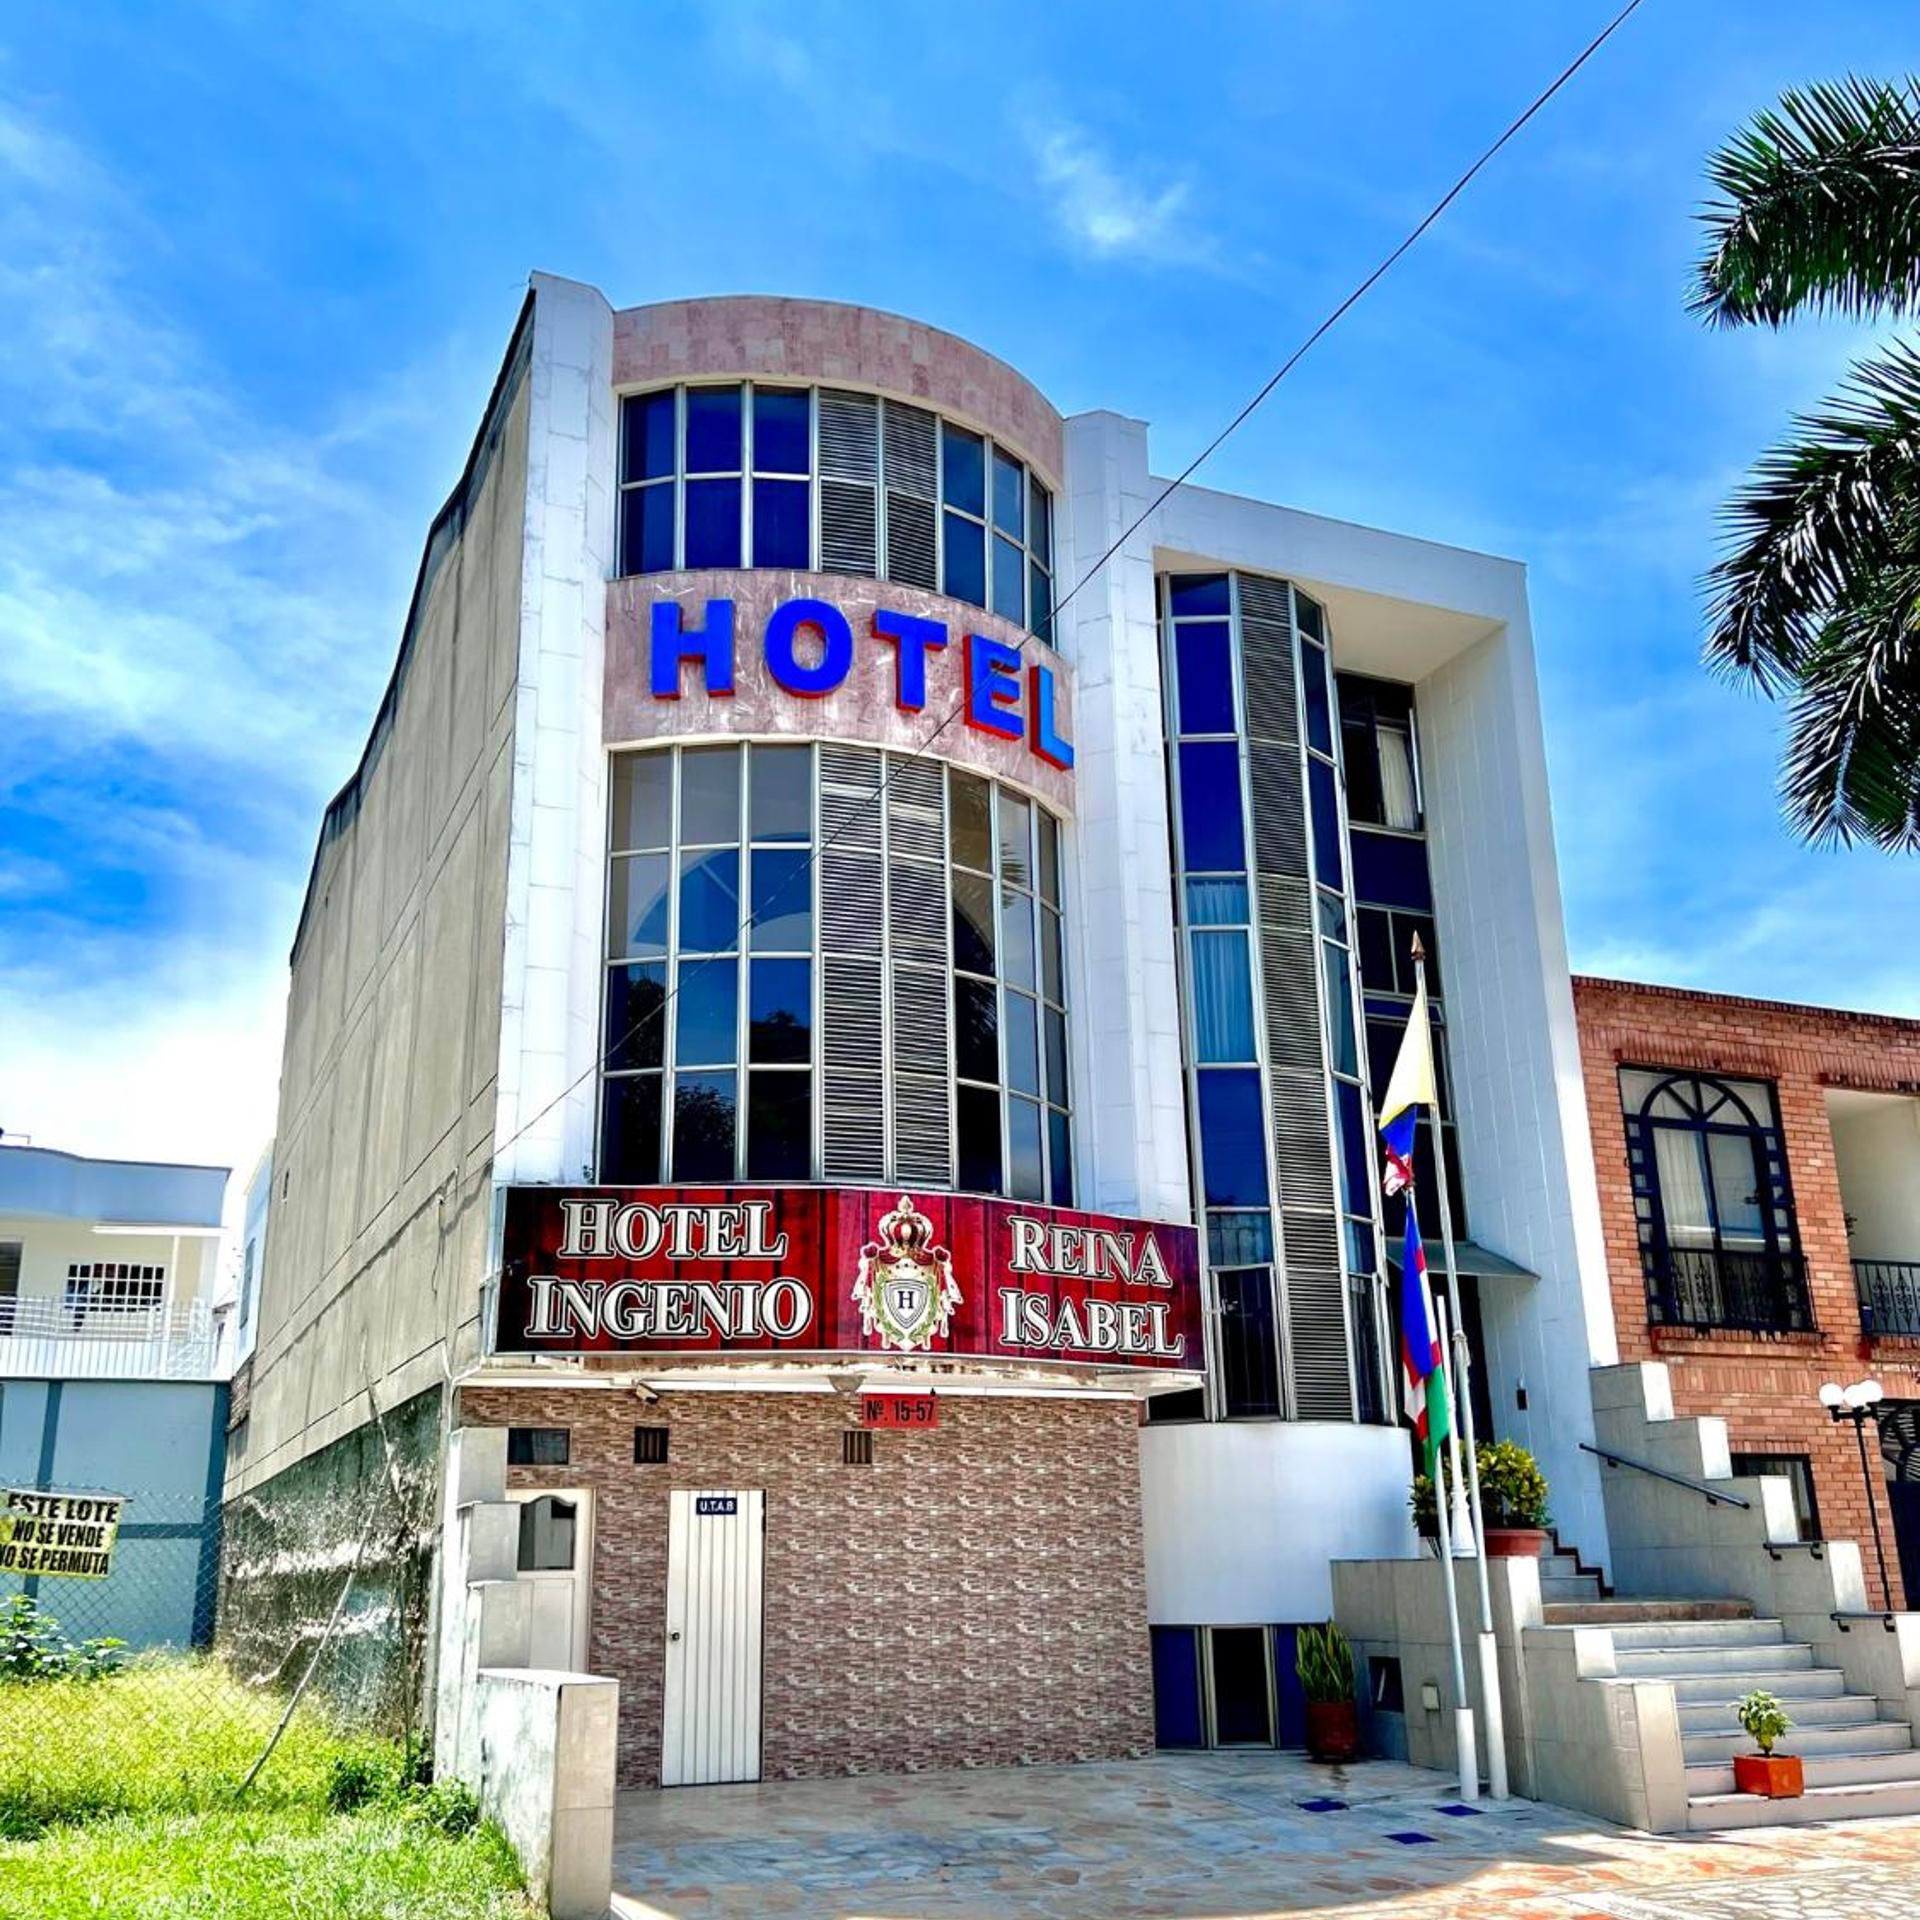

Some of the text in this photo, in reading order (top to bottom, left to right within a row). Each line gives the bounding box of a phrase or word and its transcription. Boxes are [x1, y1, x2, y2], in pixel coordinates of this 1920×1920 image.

[650, 598, 1074, 770] HOTEL
[557, 1199, 788, 1259] HOTEL
[1007, 1215, 1173, 1288] REINA
[525, 1276, 813, 1339] INGENIO
[897, 1290, 914, 1309] H
[998, 1288, 1185, 1359] ISABEL
[894, 1401, 935, 1421] 15-57
[8, 1493, 119, 1522] ESTE LOTE
[12, 1519, 105, 1547] NO SE VENDE
[18, 1546, 38, 1570] SE
[39, 1548, 110, 1574] PERMUTA
